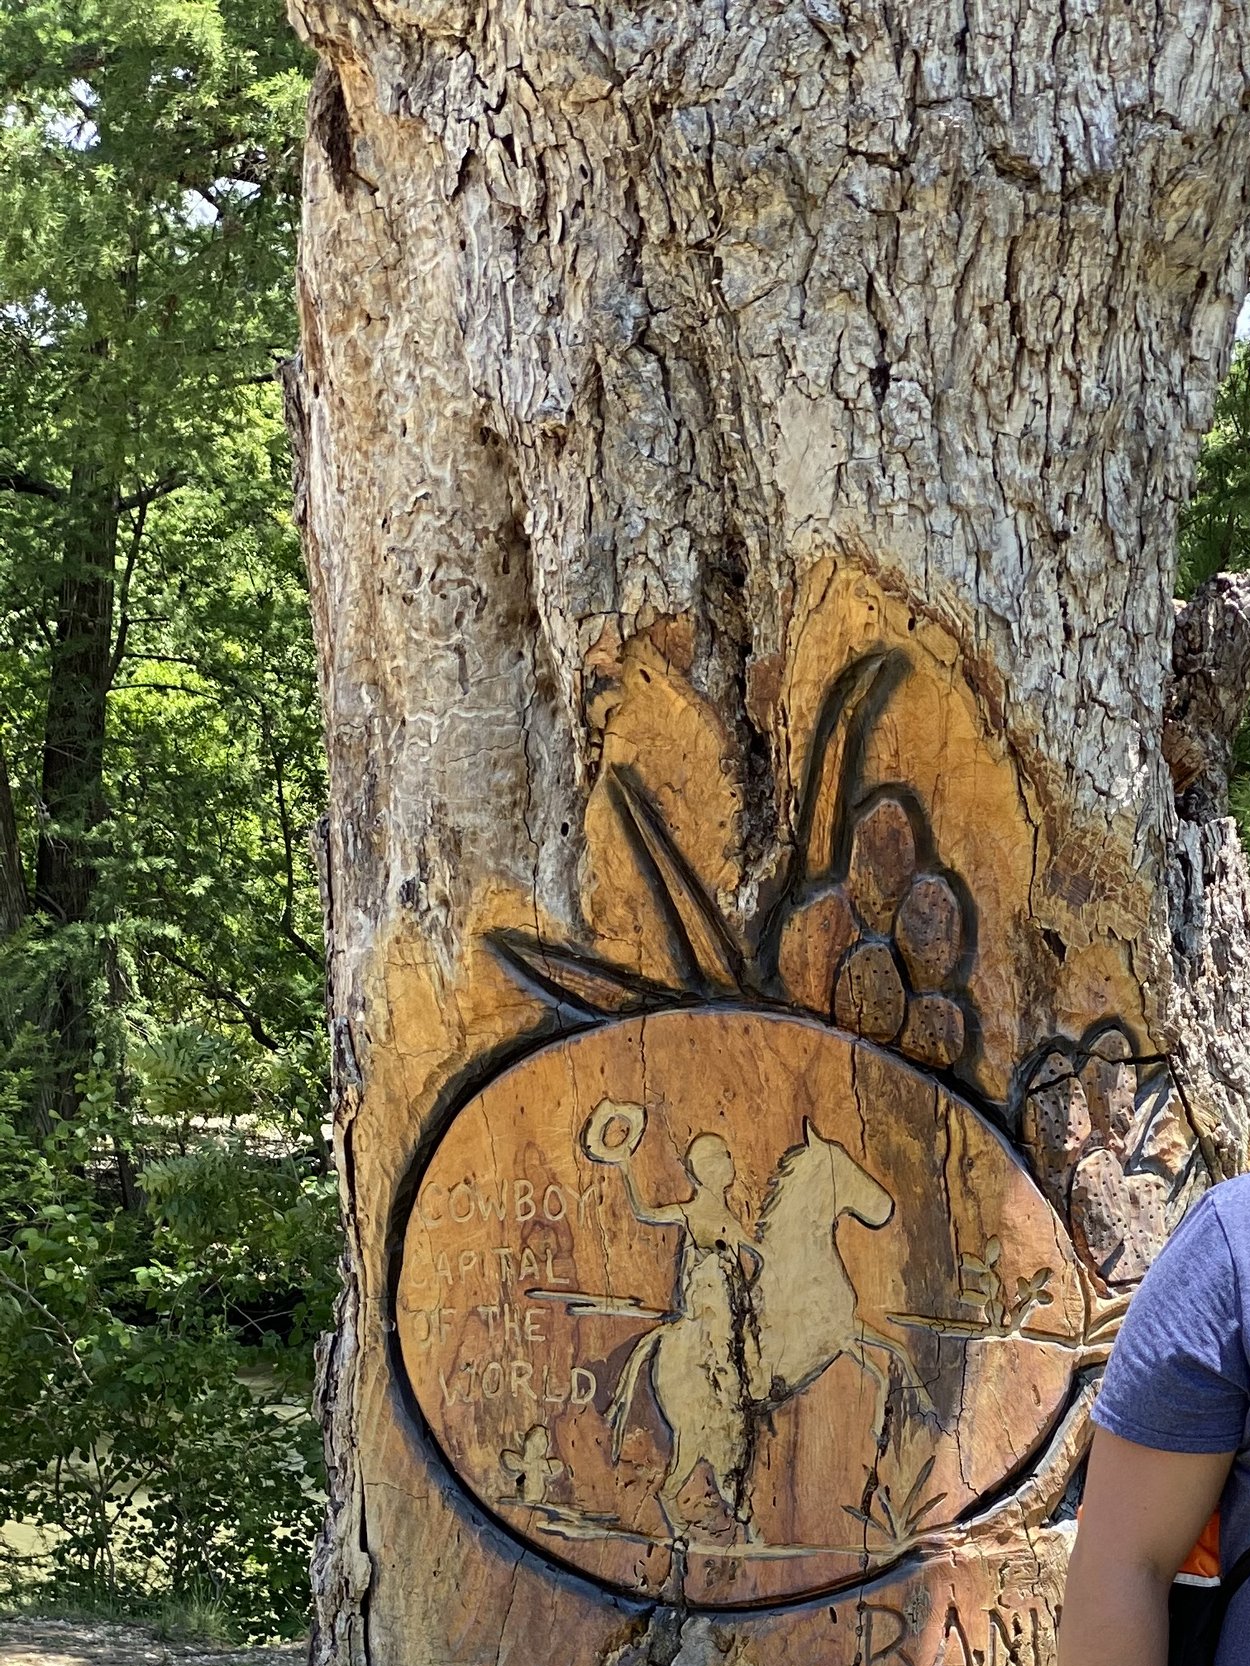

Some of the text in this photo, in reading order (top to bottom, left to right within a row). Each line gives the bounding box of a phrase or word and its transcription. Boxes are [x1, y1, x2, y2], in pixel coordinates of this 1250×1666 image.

[419, 1178, 601, 1228] COWBOY
[410, 1246, 570, 1289] CAPITAL
[412, 1303, 548, 1349] OF THE
[438, 1359, 597, 1407] WORLD
